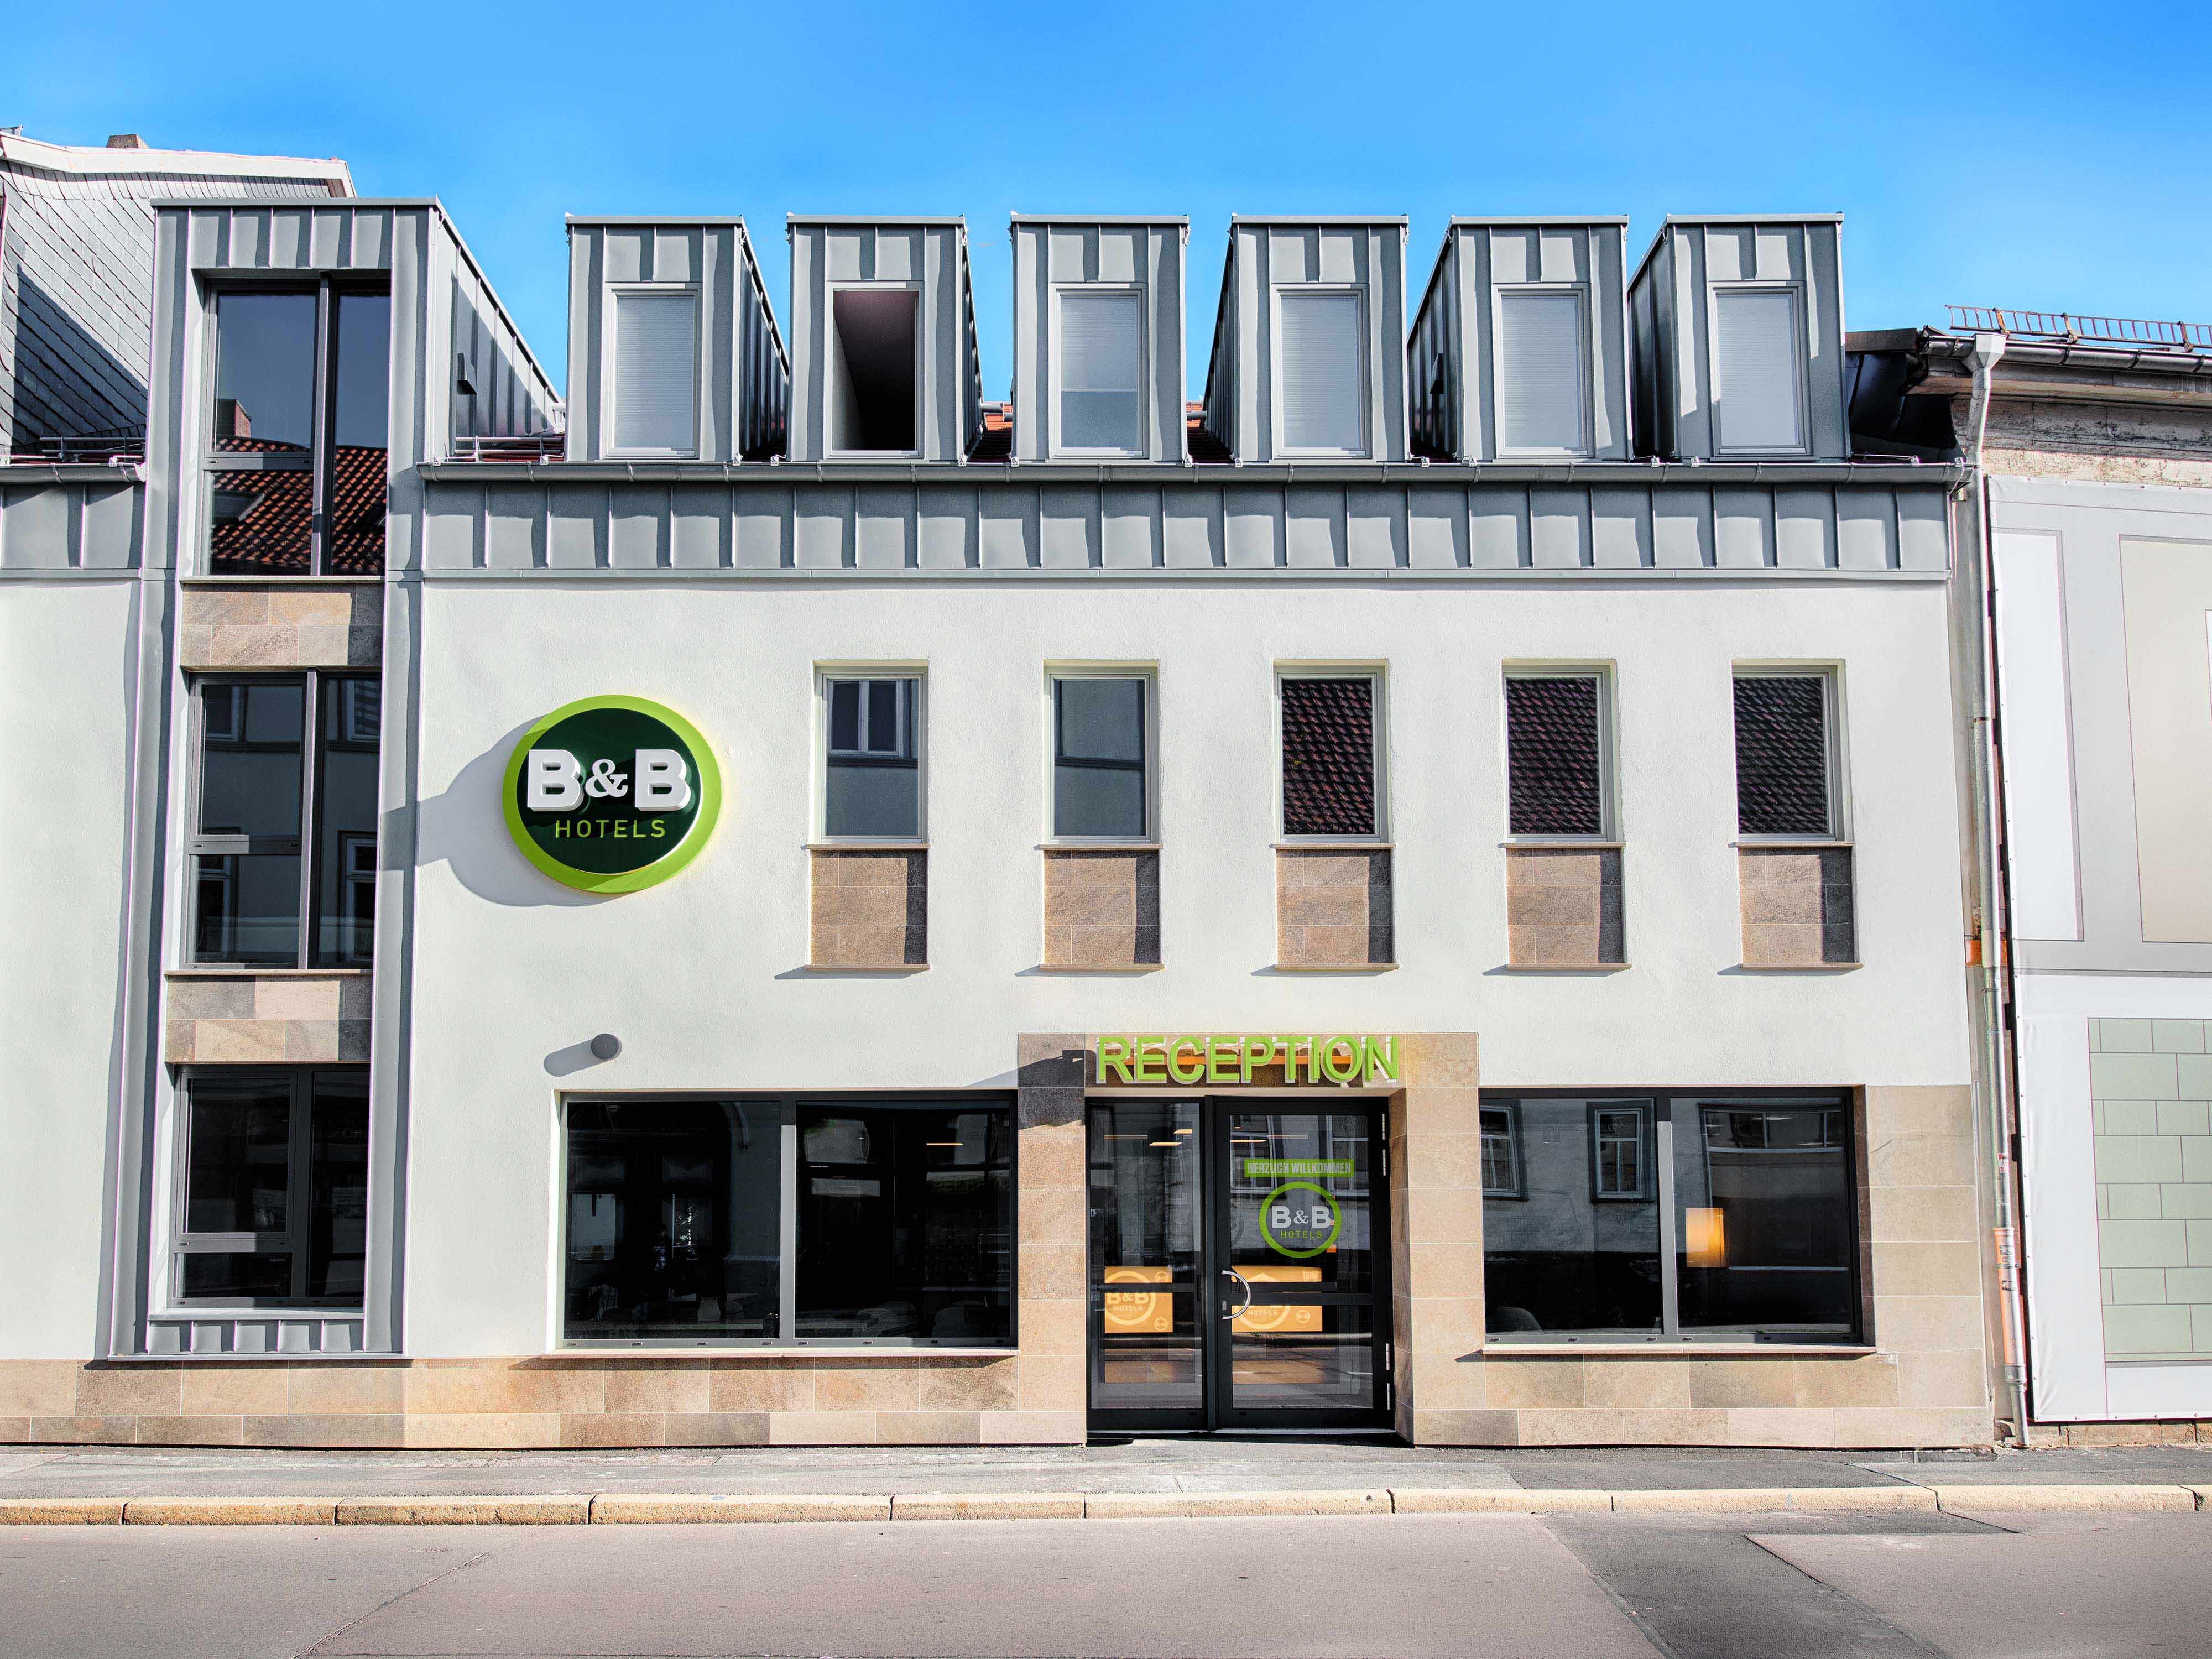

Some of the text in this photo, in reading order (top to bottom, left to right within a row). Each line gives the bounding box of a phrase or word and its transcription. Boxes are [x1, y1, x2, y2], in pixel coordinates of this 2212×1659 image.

[527, 749, 691, 811] B&B
[555, 820, 666, 838] HOTELS
[1096, 1035, 1399, 1083] RECEPTION
[1248, 1162, 1350, 1173] HERZLICH WILLKOMMEN
[1272, 1206, 1332, 1228] B&B
[1281, 1230, 1323, 1239] HOTELS
